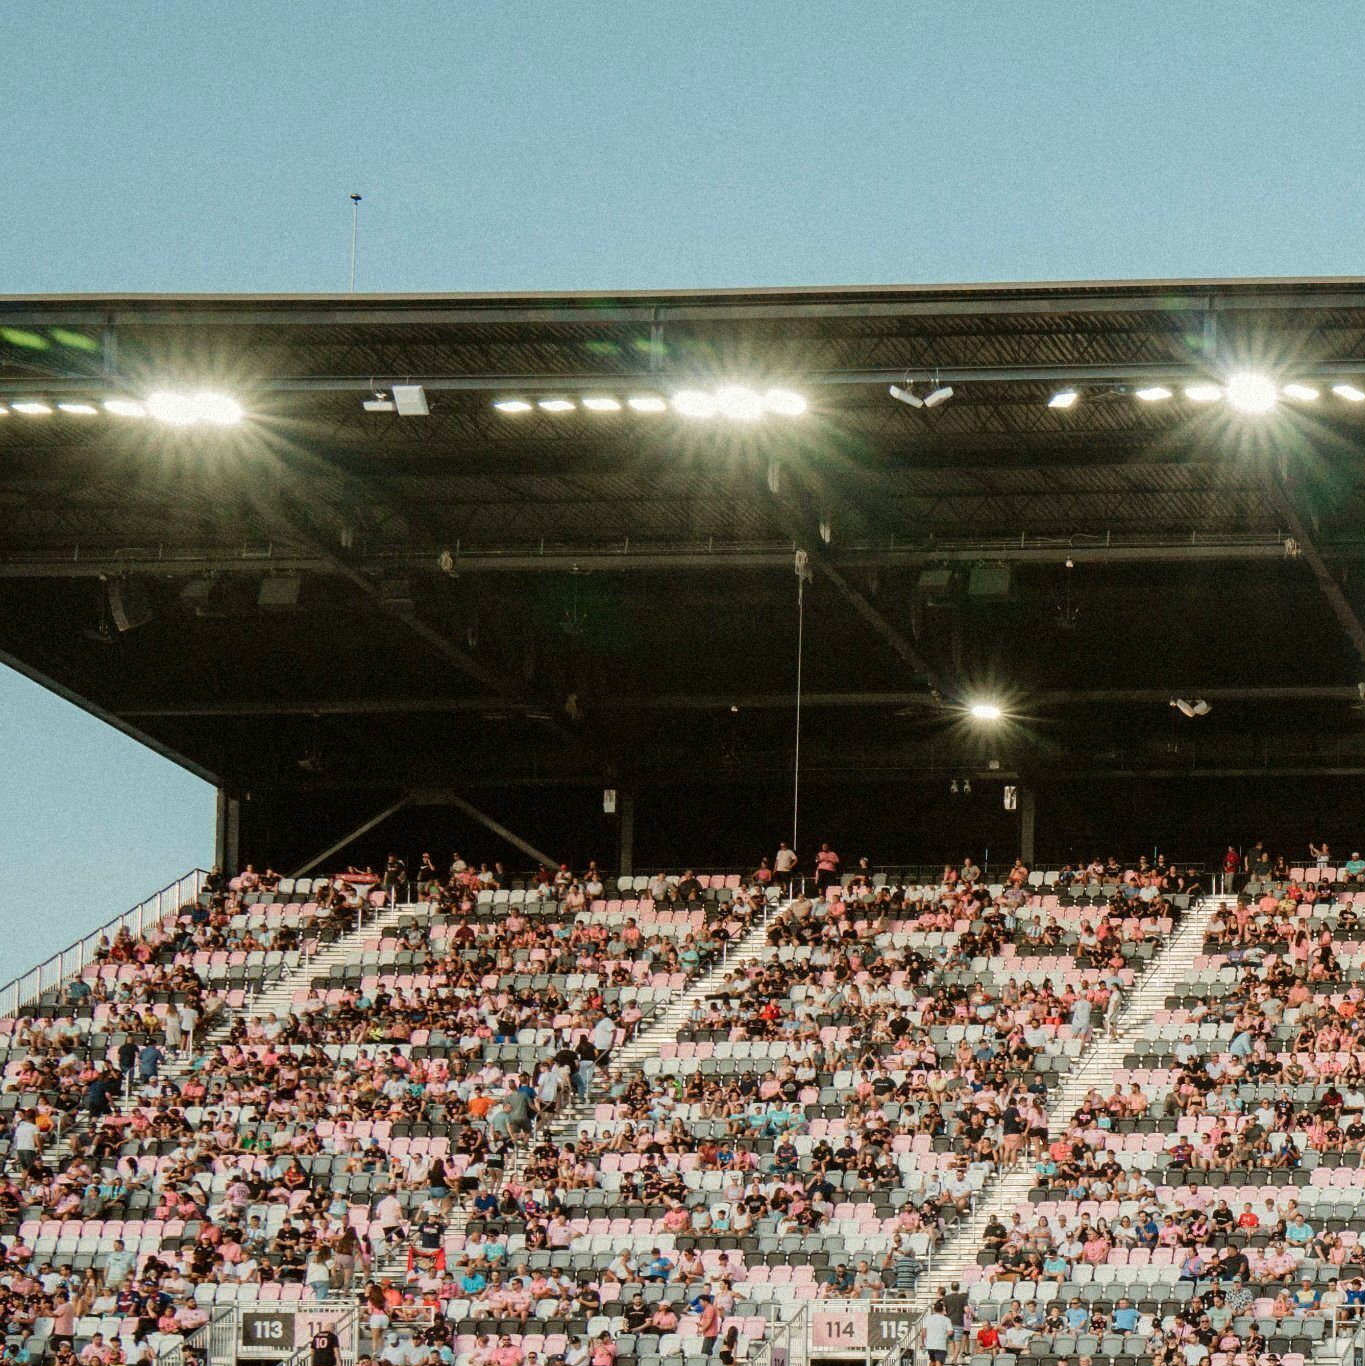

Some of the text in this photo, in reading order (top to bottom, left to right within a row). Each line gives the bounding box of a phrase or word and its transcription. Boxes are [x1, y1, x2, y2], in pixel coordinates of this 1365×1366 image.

[254, 1321, 284, 1338] 113
[826, 1322, 856, 1338] 114
[880, 1321, 909, 1340] 115
[315, 1337, 328, 1348] 10
